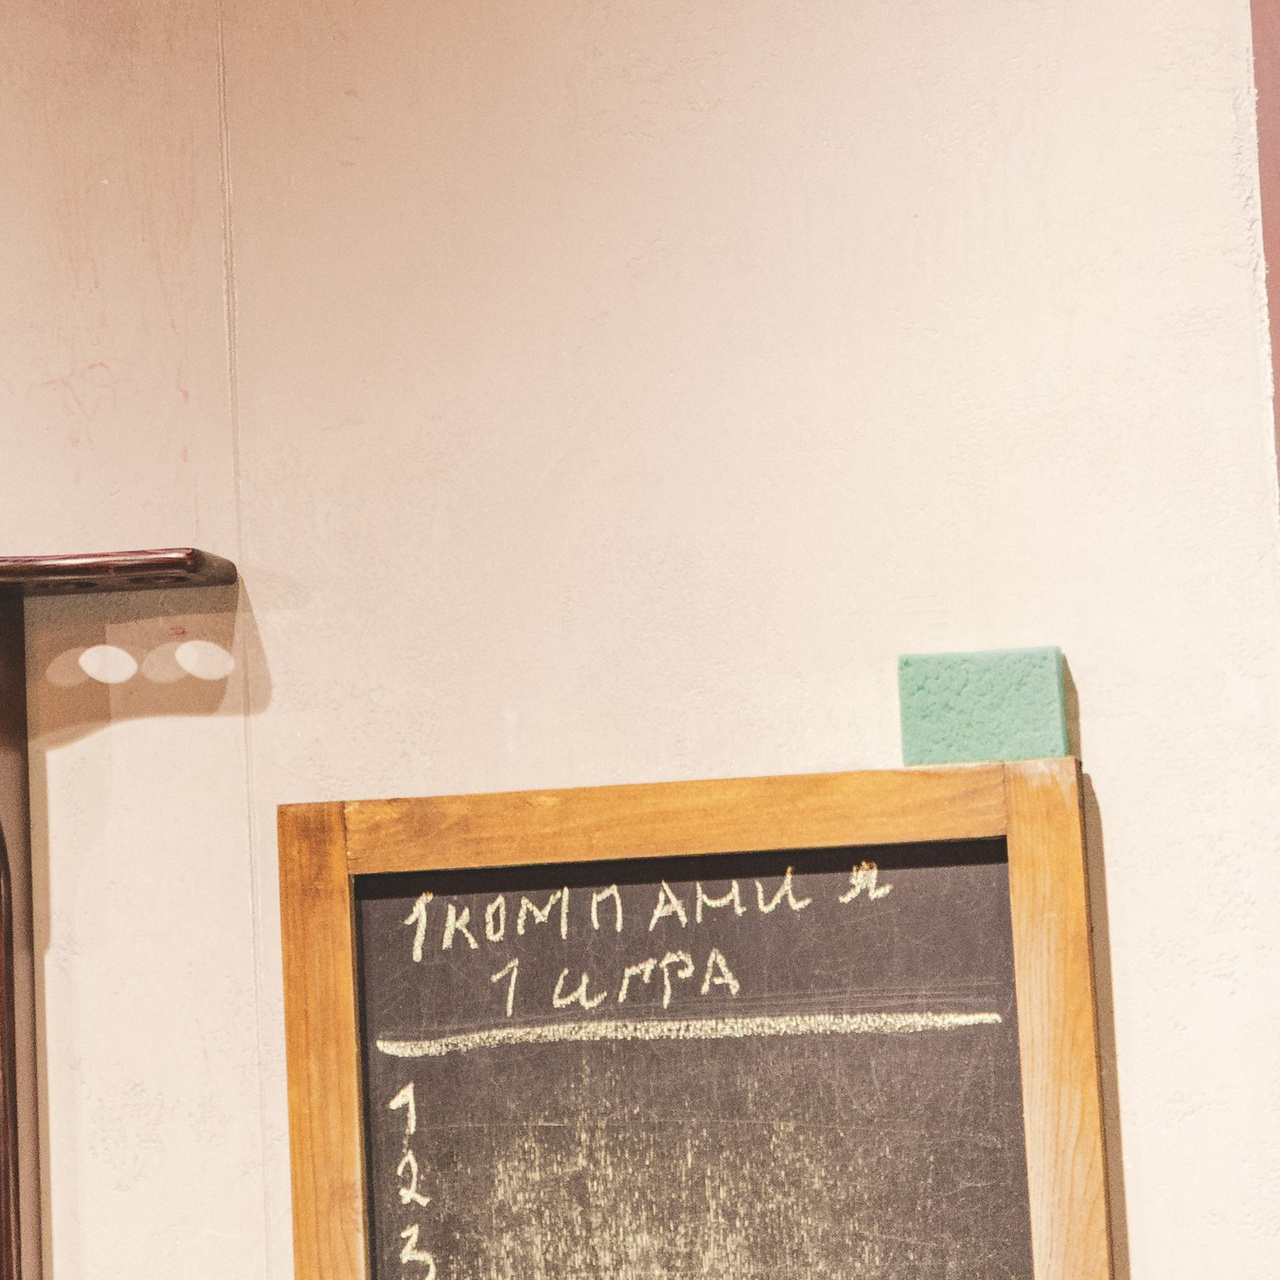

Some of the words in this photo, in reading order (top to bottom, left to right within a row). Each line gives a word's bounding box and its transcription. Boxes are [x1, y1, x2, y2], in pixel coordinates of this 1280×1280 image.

[404, 892, 434, 963] 1
[490, 957, 519, 1017] 1
[388, 1080, 416, 1146] 1
[396, 1150, 430, 1207] 2
[400, 1223, 437, 1280] 3
